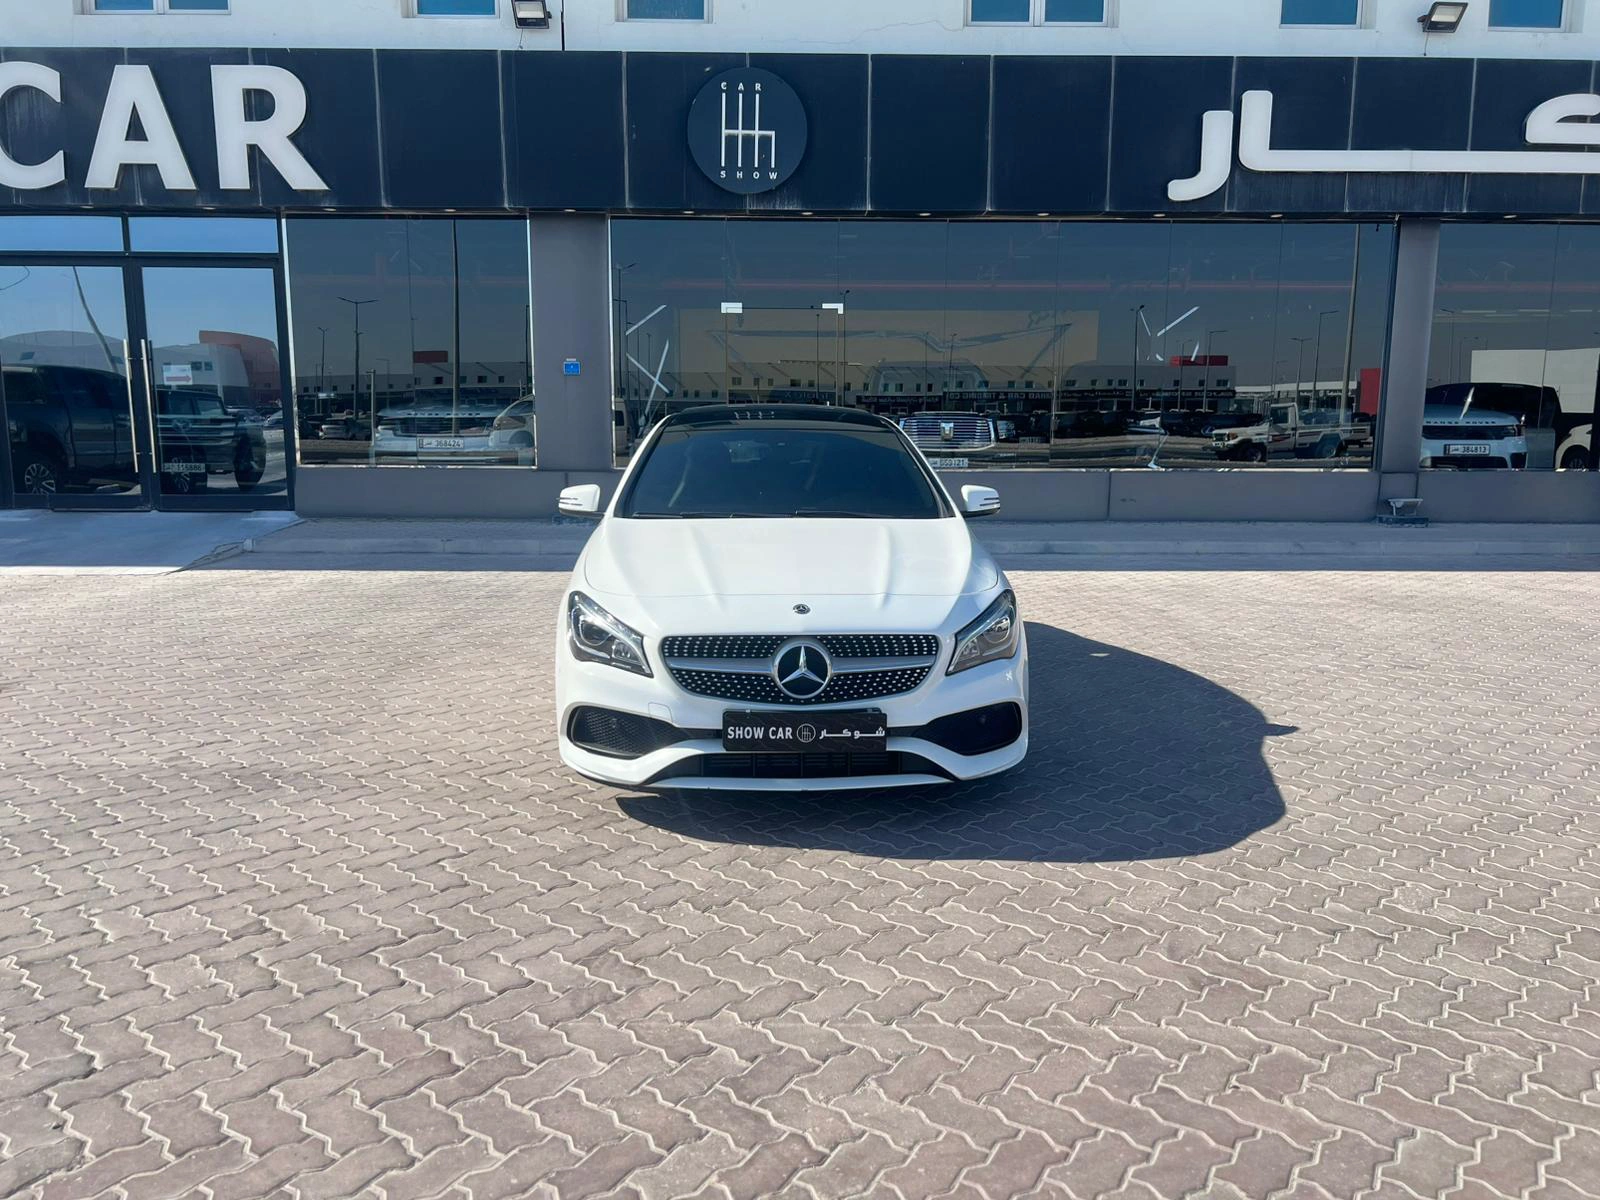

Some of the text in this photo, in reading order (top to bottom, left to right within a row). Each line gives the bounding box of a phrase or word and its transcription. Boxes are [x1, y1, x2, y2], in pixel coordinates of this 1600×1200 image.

[721, 82, 762, 91] CAR
[0, 61, 330, 189] CAR
[720, 170, 778, 180] SHOW
[727, 726, 793, 740] SHOW CAR
[819, 726, 886, 740] شو كار
